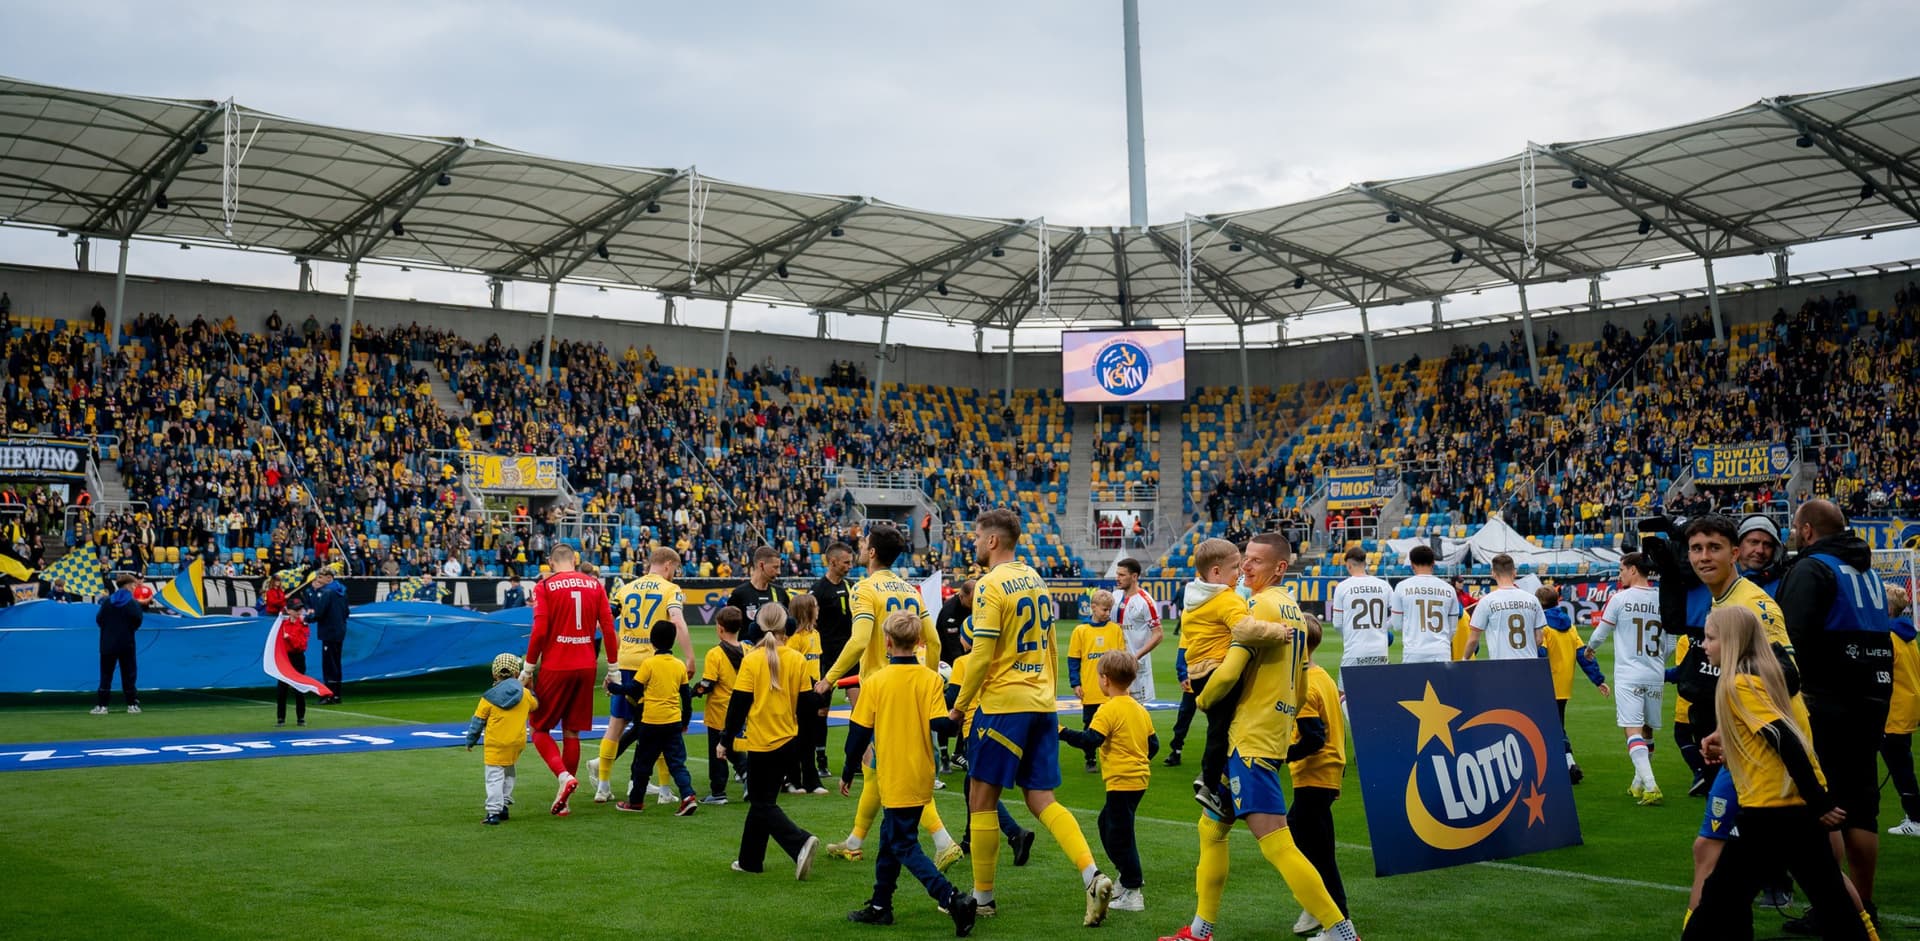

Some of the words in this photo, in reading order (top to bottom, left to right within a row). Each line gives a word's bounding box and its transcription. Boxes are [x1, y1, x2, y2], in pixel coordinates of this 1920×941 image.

[1712, 456, 1769, 479] PUCKI
[1713, 446, 1769, 460] POWIAT
[548, 577, 598, 592] GROBELNY
[633, 581, 661, 591] KERK
[1350, 585, 1384, 595] JOSEMA
[1405, 586, 1452, 598] MASSIMO
[1838, 564, 1884, 610] TV
[571, 591, 582, 631] 1
[624, 593, 663, 629] 37
[1351, 598, 1384, 630] 20
[1415, 599, 1444, 633] 15
[1624, 600, 1660, 615] SADÍL
[1016, 594, 1053, 654] 29
[1508, 614, 1527, 650] 8
[1632, 617, 1662, 658] 13
[1699, 661, 1721, 677] 210
[1432, 733, 1523, 820] LOTTO
